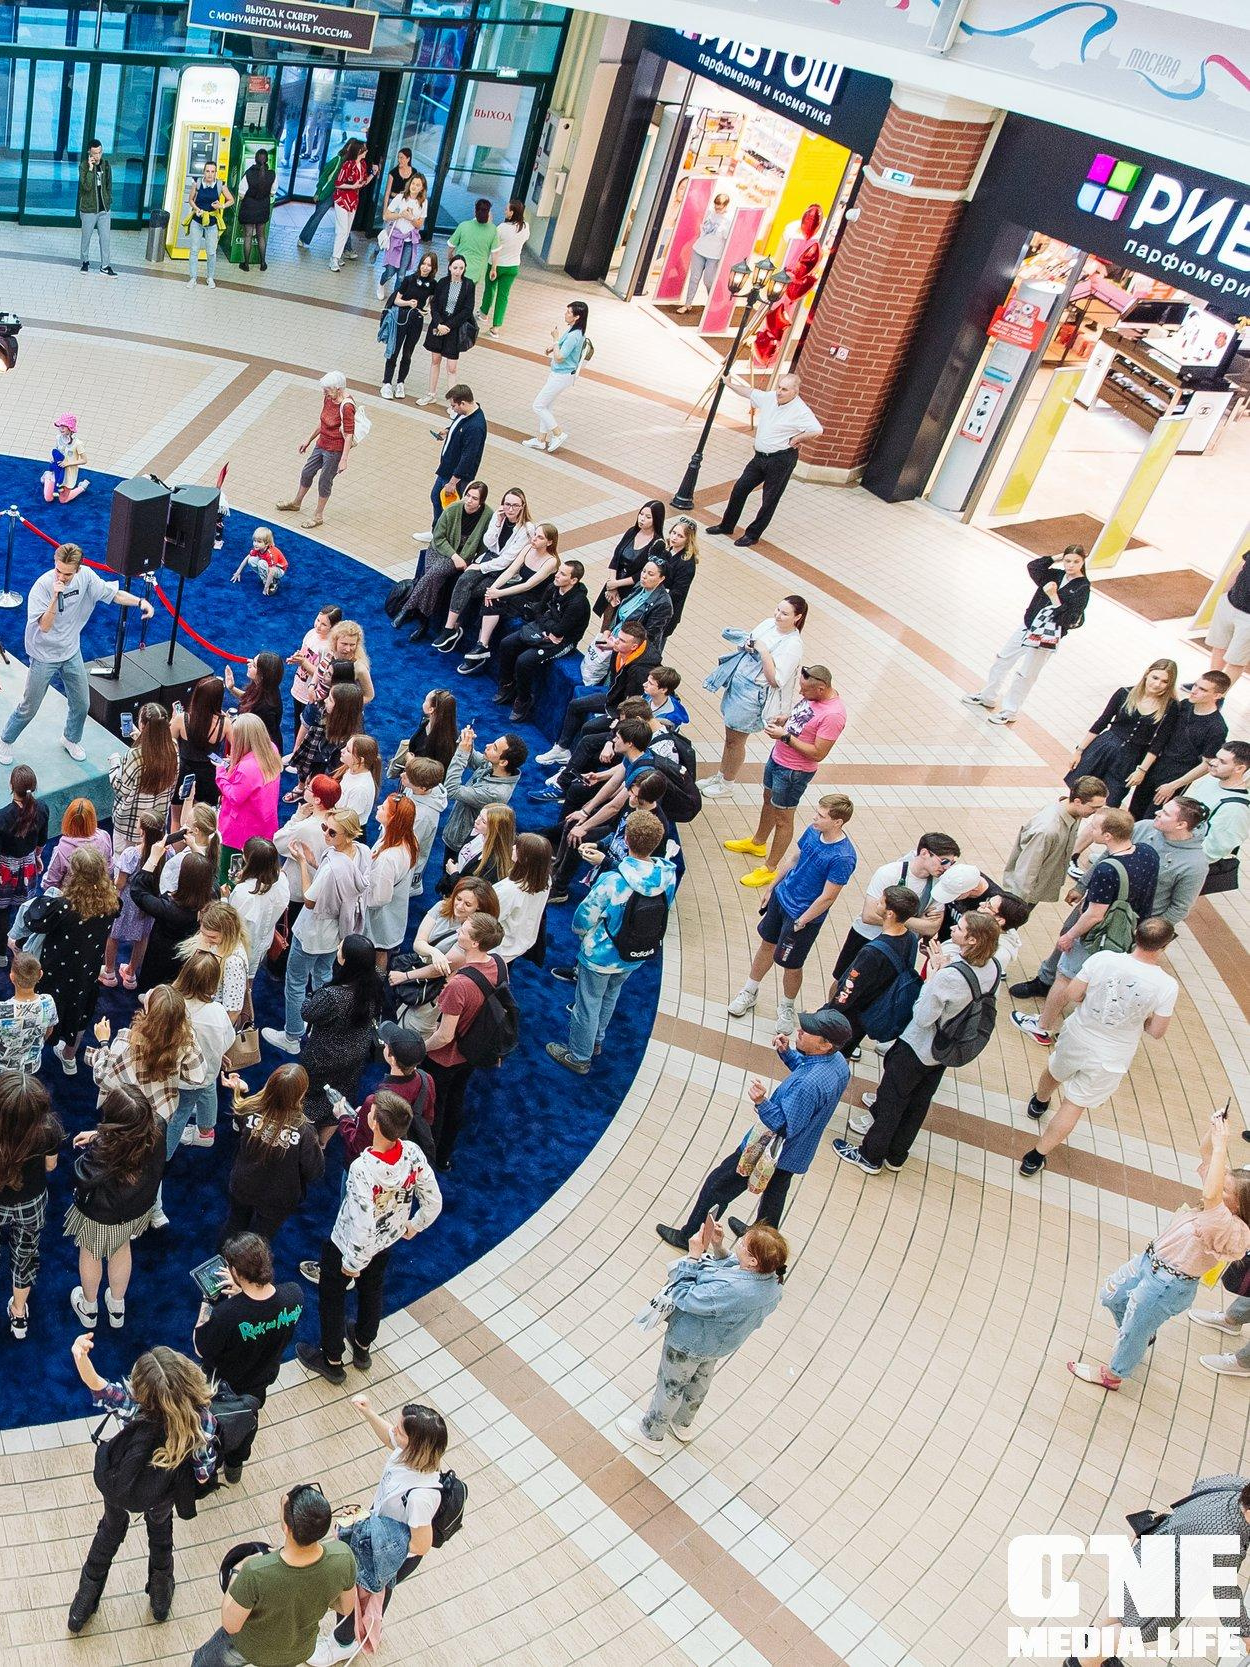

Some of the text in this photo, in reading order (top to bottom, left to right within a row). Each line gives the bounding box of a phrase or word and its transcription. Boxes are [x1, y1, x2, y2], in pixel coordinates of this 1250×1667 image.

[208, 9, 216, 19] С
[216, 11, 282, 29] МОНУМЕНТОМ
[312, 27, 353, 39] РОССИЯ»
[245, 4, 319, 23] ВЫХОД К СКВЕРУ
[699, 52, 832, 126] парфюмерия и косметика
[474, 108, 513, 122] ВЫХОД
